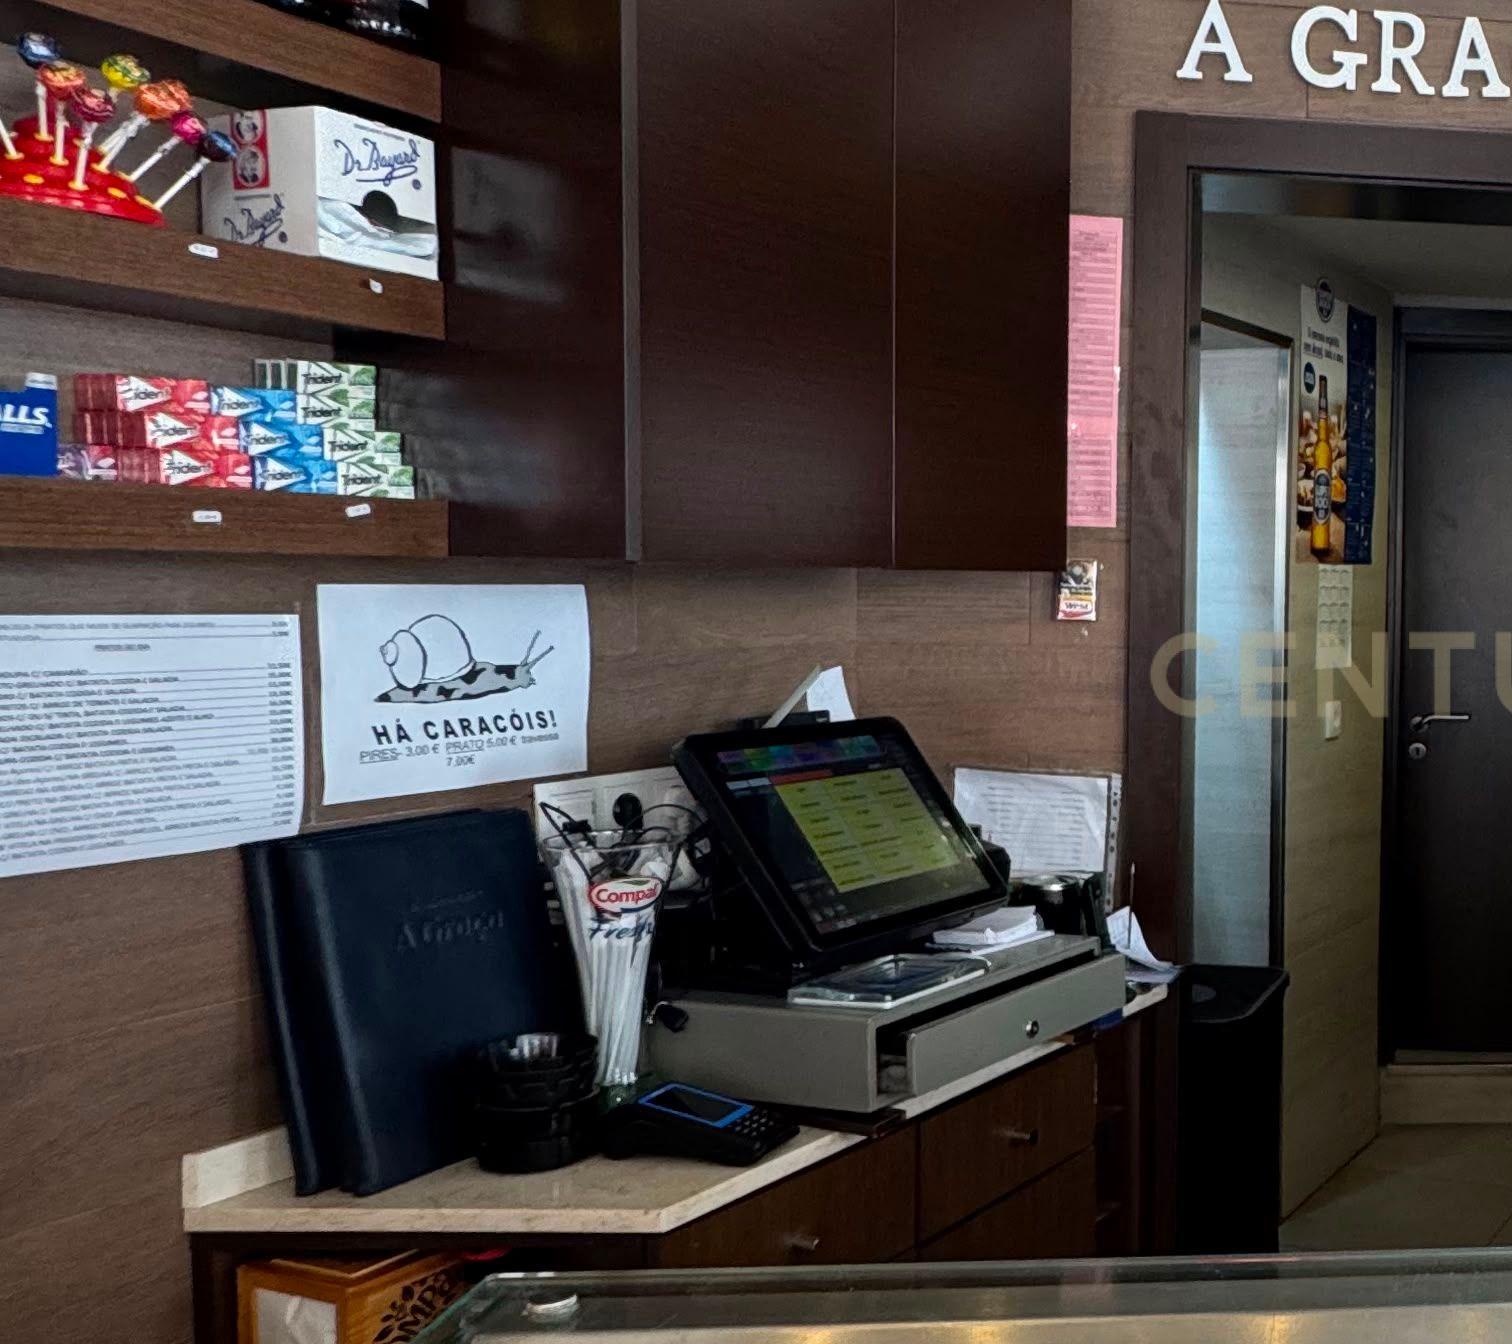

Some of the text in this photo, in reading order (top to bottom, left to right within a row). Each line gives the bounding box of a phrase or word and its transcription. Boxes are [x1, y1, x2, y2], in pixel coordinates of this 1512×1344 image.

[301, 372, 343, 385] Trident
[301, 405, 343, 419] Trident
[328, 439, 369, 453] Trident
[341, 472, 383, 486] Trident
[423, 708, 558, 741] CARACÓIS!
[596, 882, 660, 905] Compal
